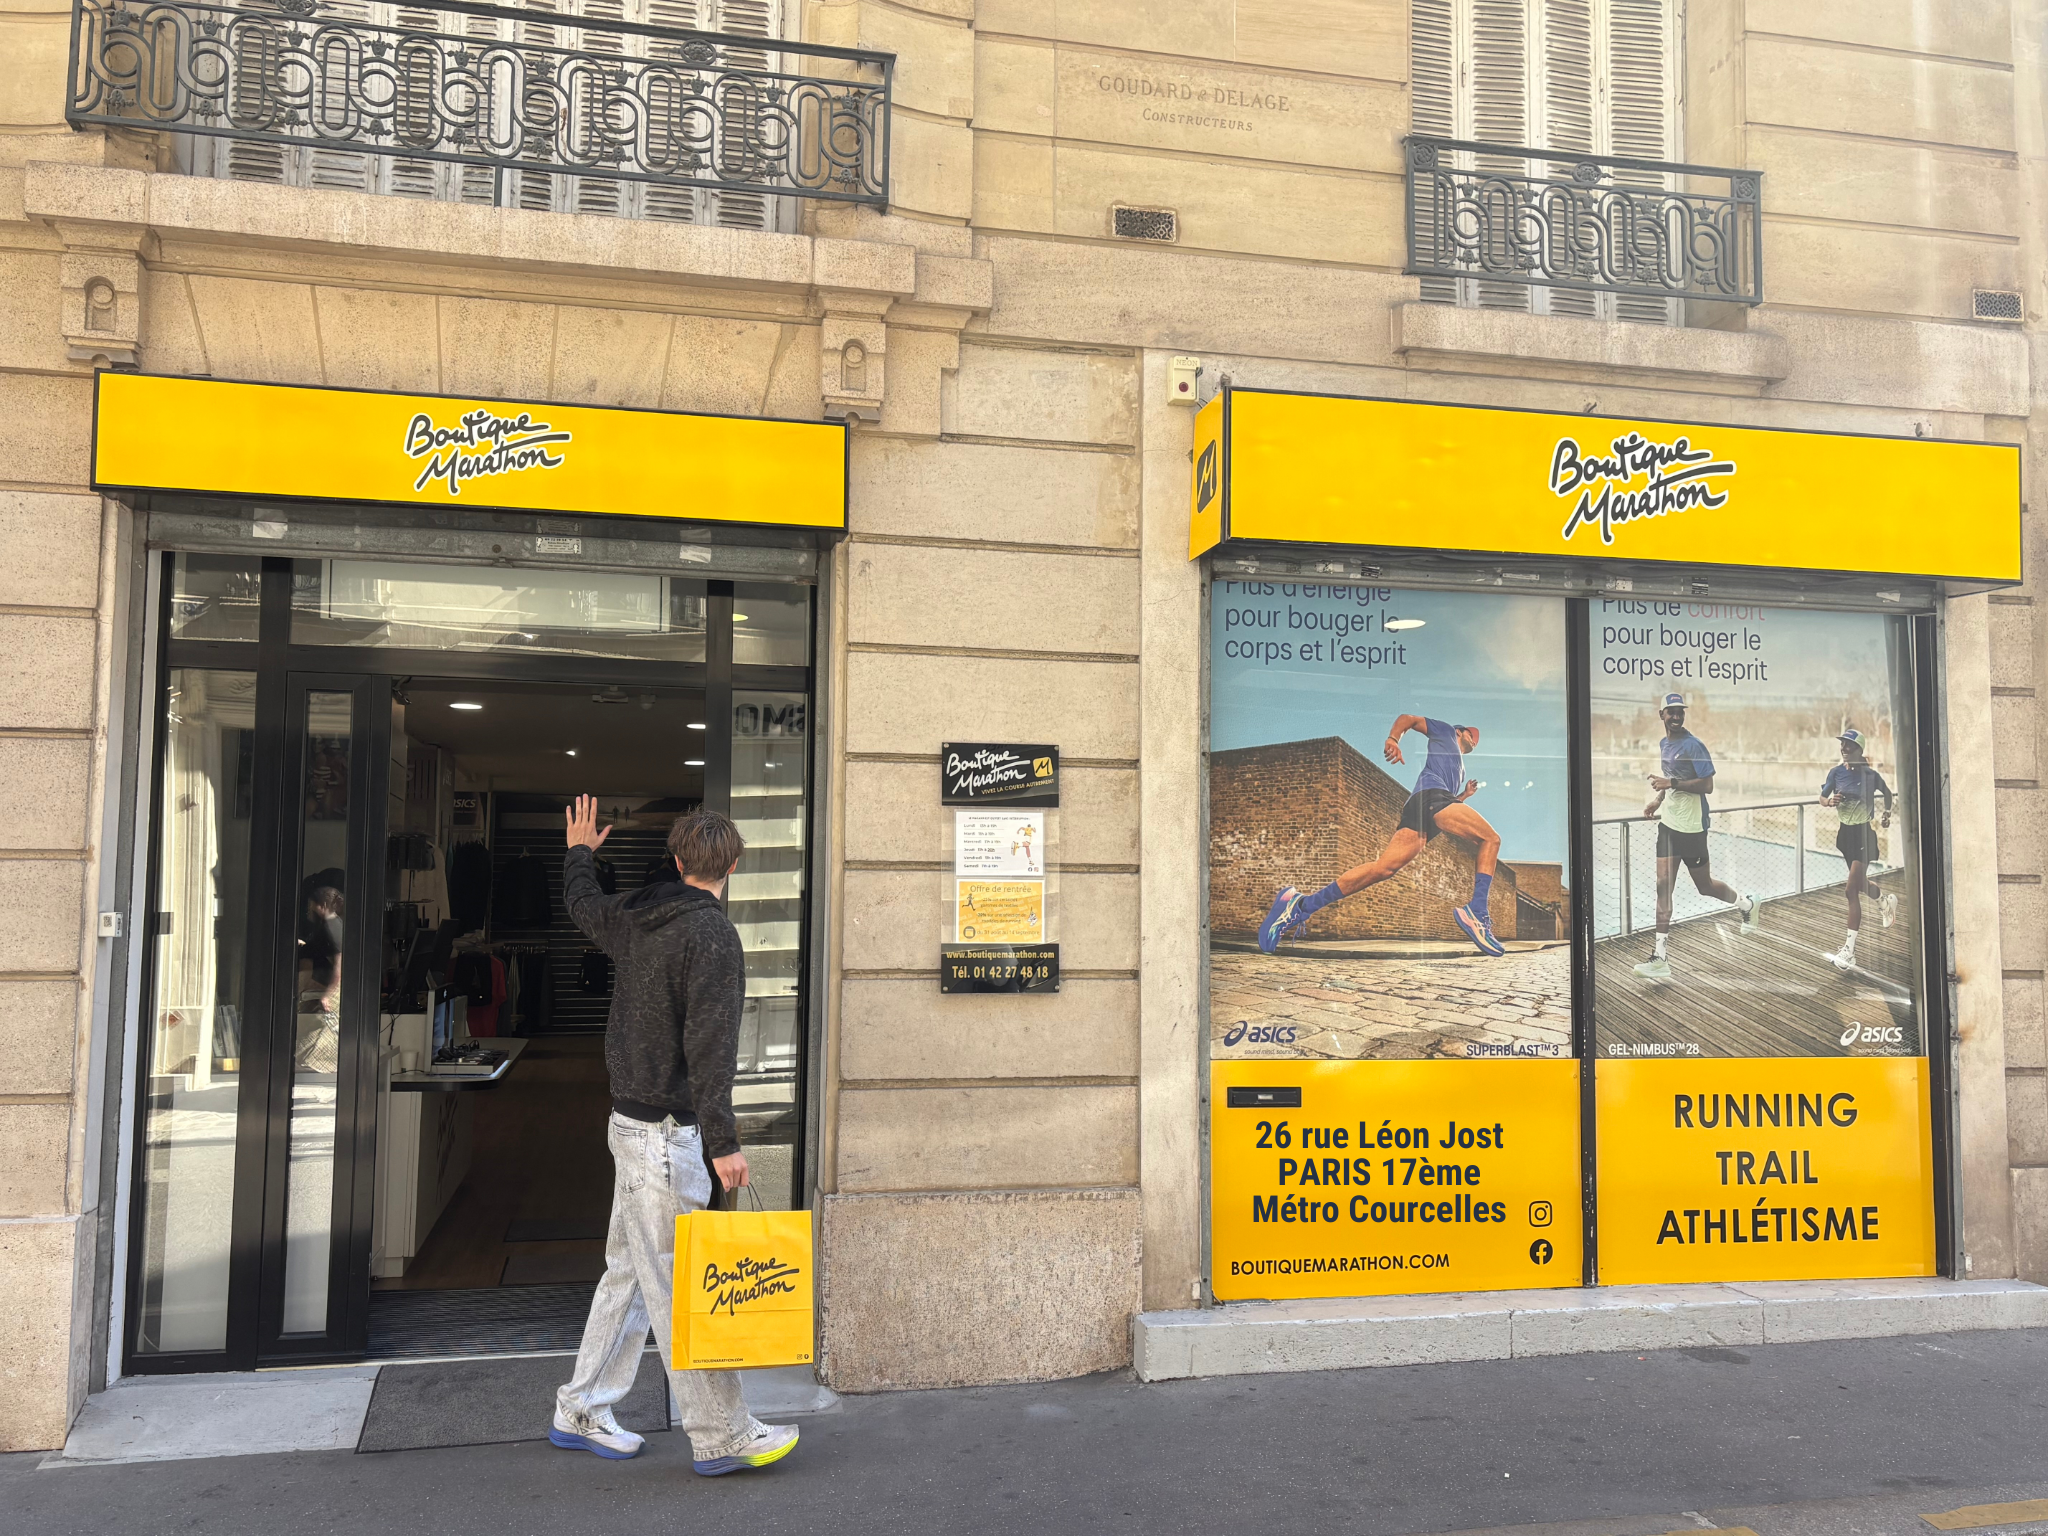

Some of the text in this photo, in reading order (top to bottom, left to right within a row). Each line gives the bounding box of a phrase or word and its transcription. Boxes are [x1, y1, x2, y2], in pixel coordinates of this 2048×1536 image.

[1099, 75, 1290, 112] GOUDARD & DELAGE
[1142, 108, 1253, 132] CONSTRUCTEURS
[406, 410, 549, 456] Boutique
[416, 434, 570, 494] Marathon
[1552, 434, 1710, 494] Boutique
[1564, 464, 1734, 543] Marathon
[1225, 608, 1281, 632] pour
[1288, 604, 1374, 637] bouger
[1225, 638, 1406, 670] corps et l'esprit
[1603, 622, 1761, 654] pour bouger le
[1603, 655, 1768, 685] corps et l'esprit
[946, 749, 1020, 776] Boutique
[952, 760, 1030, 796] Marathon
[946, 950, 1055, 960] www.boutiquemarathon.com
[952, 966, 1048, 979] Tél. 01 42 27 48 18
[1686, 1045, 1700, 1055] 28
[1674, 1092, 1858, 1129] RUNNING
[1256, 1120, 1504, 1149] 26 rue Léon Jost
[1279, 1156, 1481, 1186] PARIS 17ème
[1716, 1150, 1818, 1185] TRAIL
[1252, 1193, 1506, 1223] Métro Courcelles
[1656, 1196, 1878, 1244] ATHLÉTISME
[703, 1257, 787, 1292] Boutique
[1232, 1254, 1450, 1276] BOUTIQUEMARATHON.COM
[710, 1268, 800, 1316] Marathon
